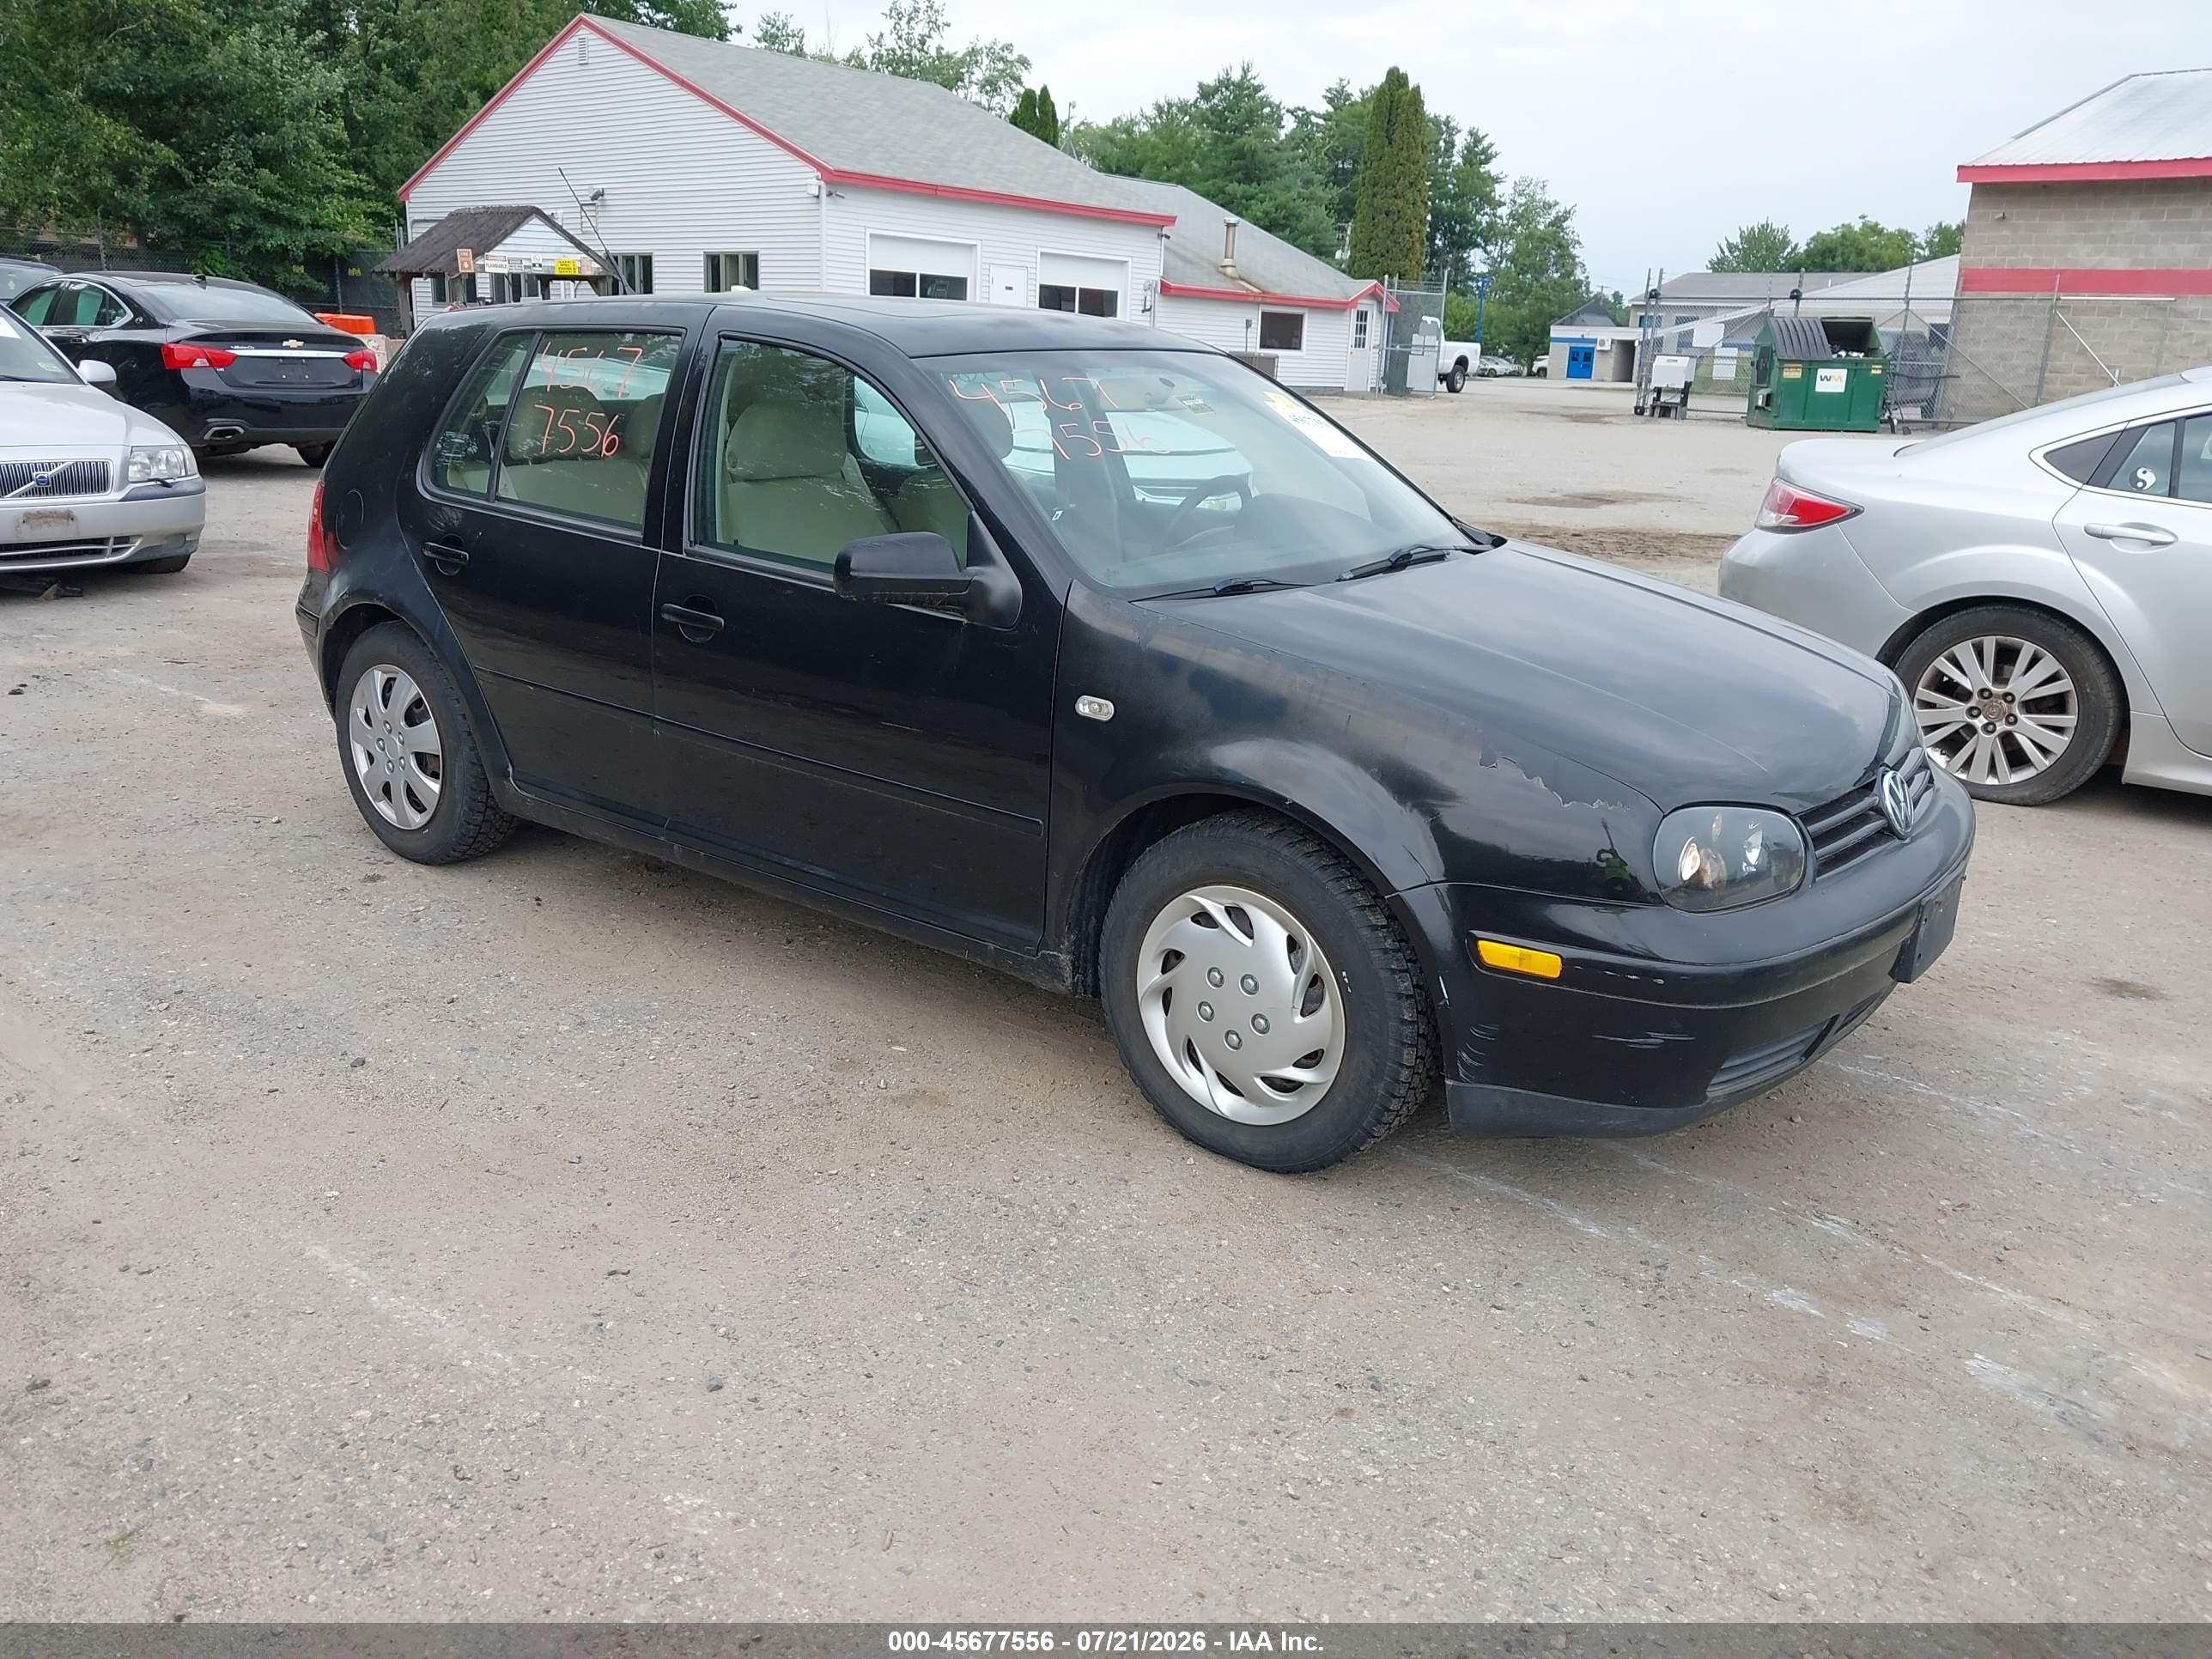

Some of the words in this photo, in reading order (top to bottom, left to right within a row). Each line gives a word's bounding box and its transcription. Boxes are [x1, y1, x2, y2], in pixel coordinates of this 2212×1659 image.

[948, 376, 1119, 414] 4567
[1820, 374, 1843, 383] WM
[534, 404, 620, 458] 7556
